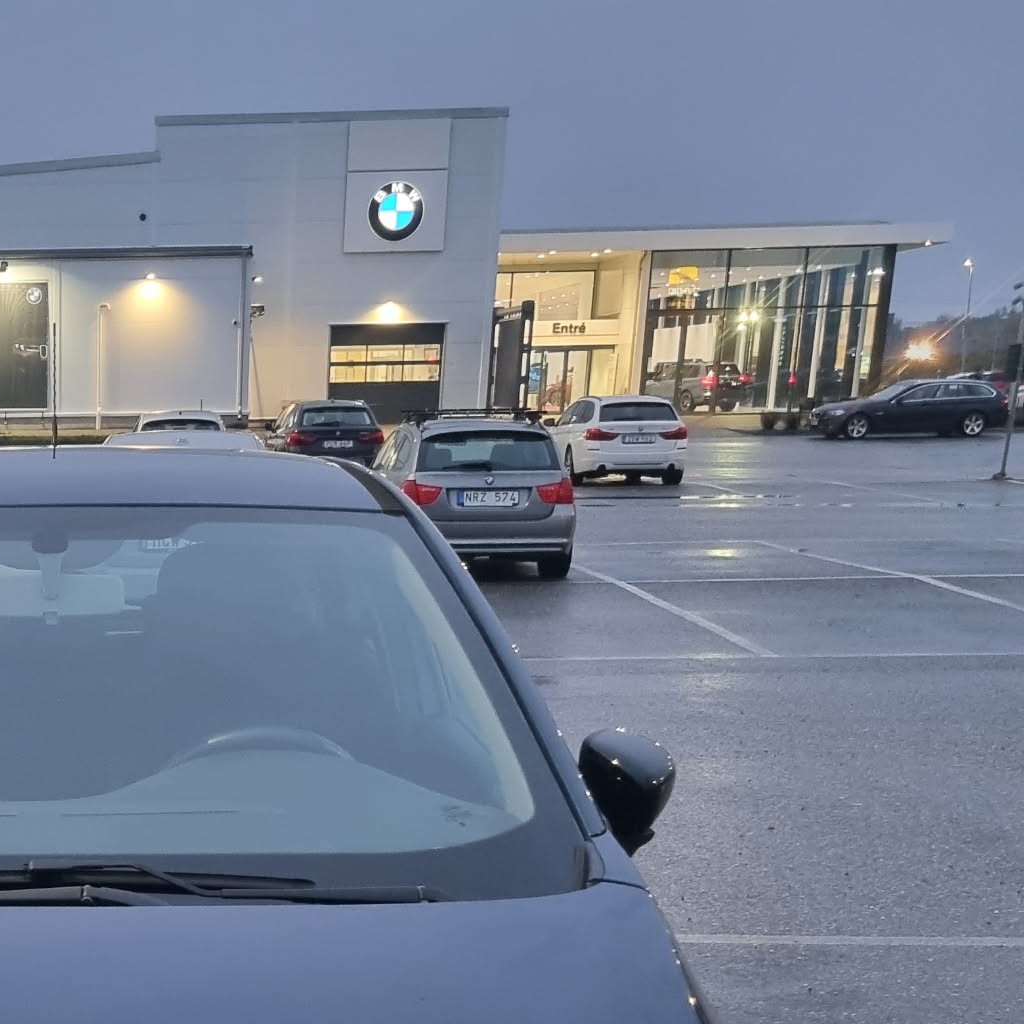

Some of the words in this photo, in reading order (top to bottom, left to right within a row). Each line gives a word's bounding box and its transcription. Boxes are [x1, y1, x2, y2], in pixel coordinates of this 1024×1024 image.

[552, 322, 586, 334] Entré
[465, 492, 487, 502] NRZ
[495, 492, 516, 502] 574
